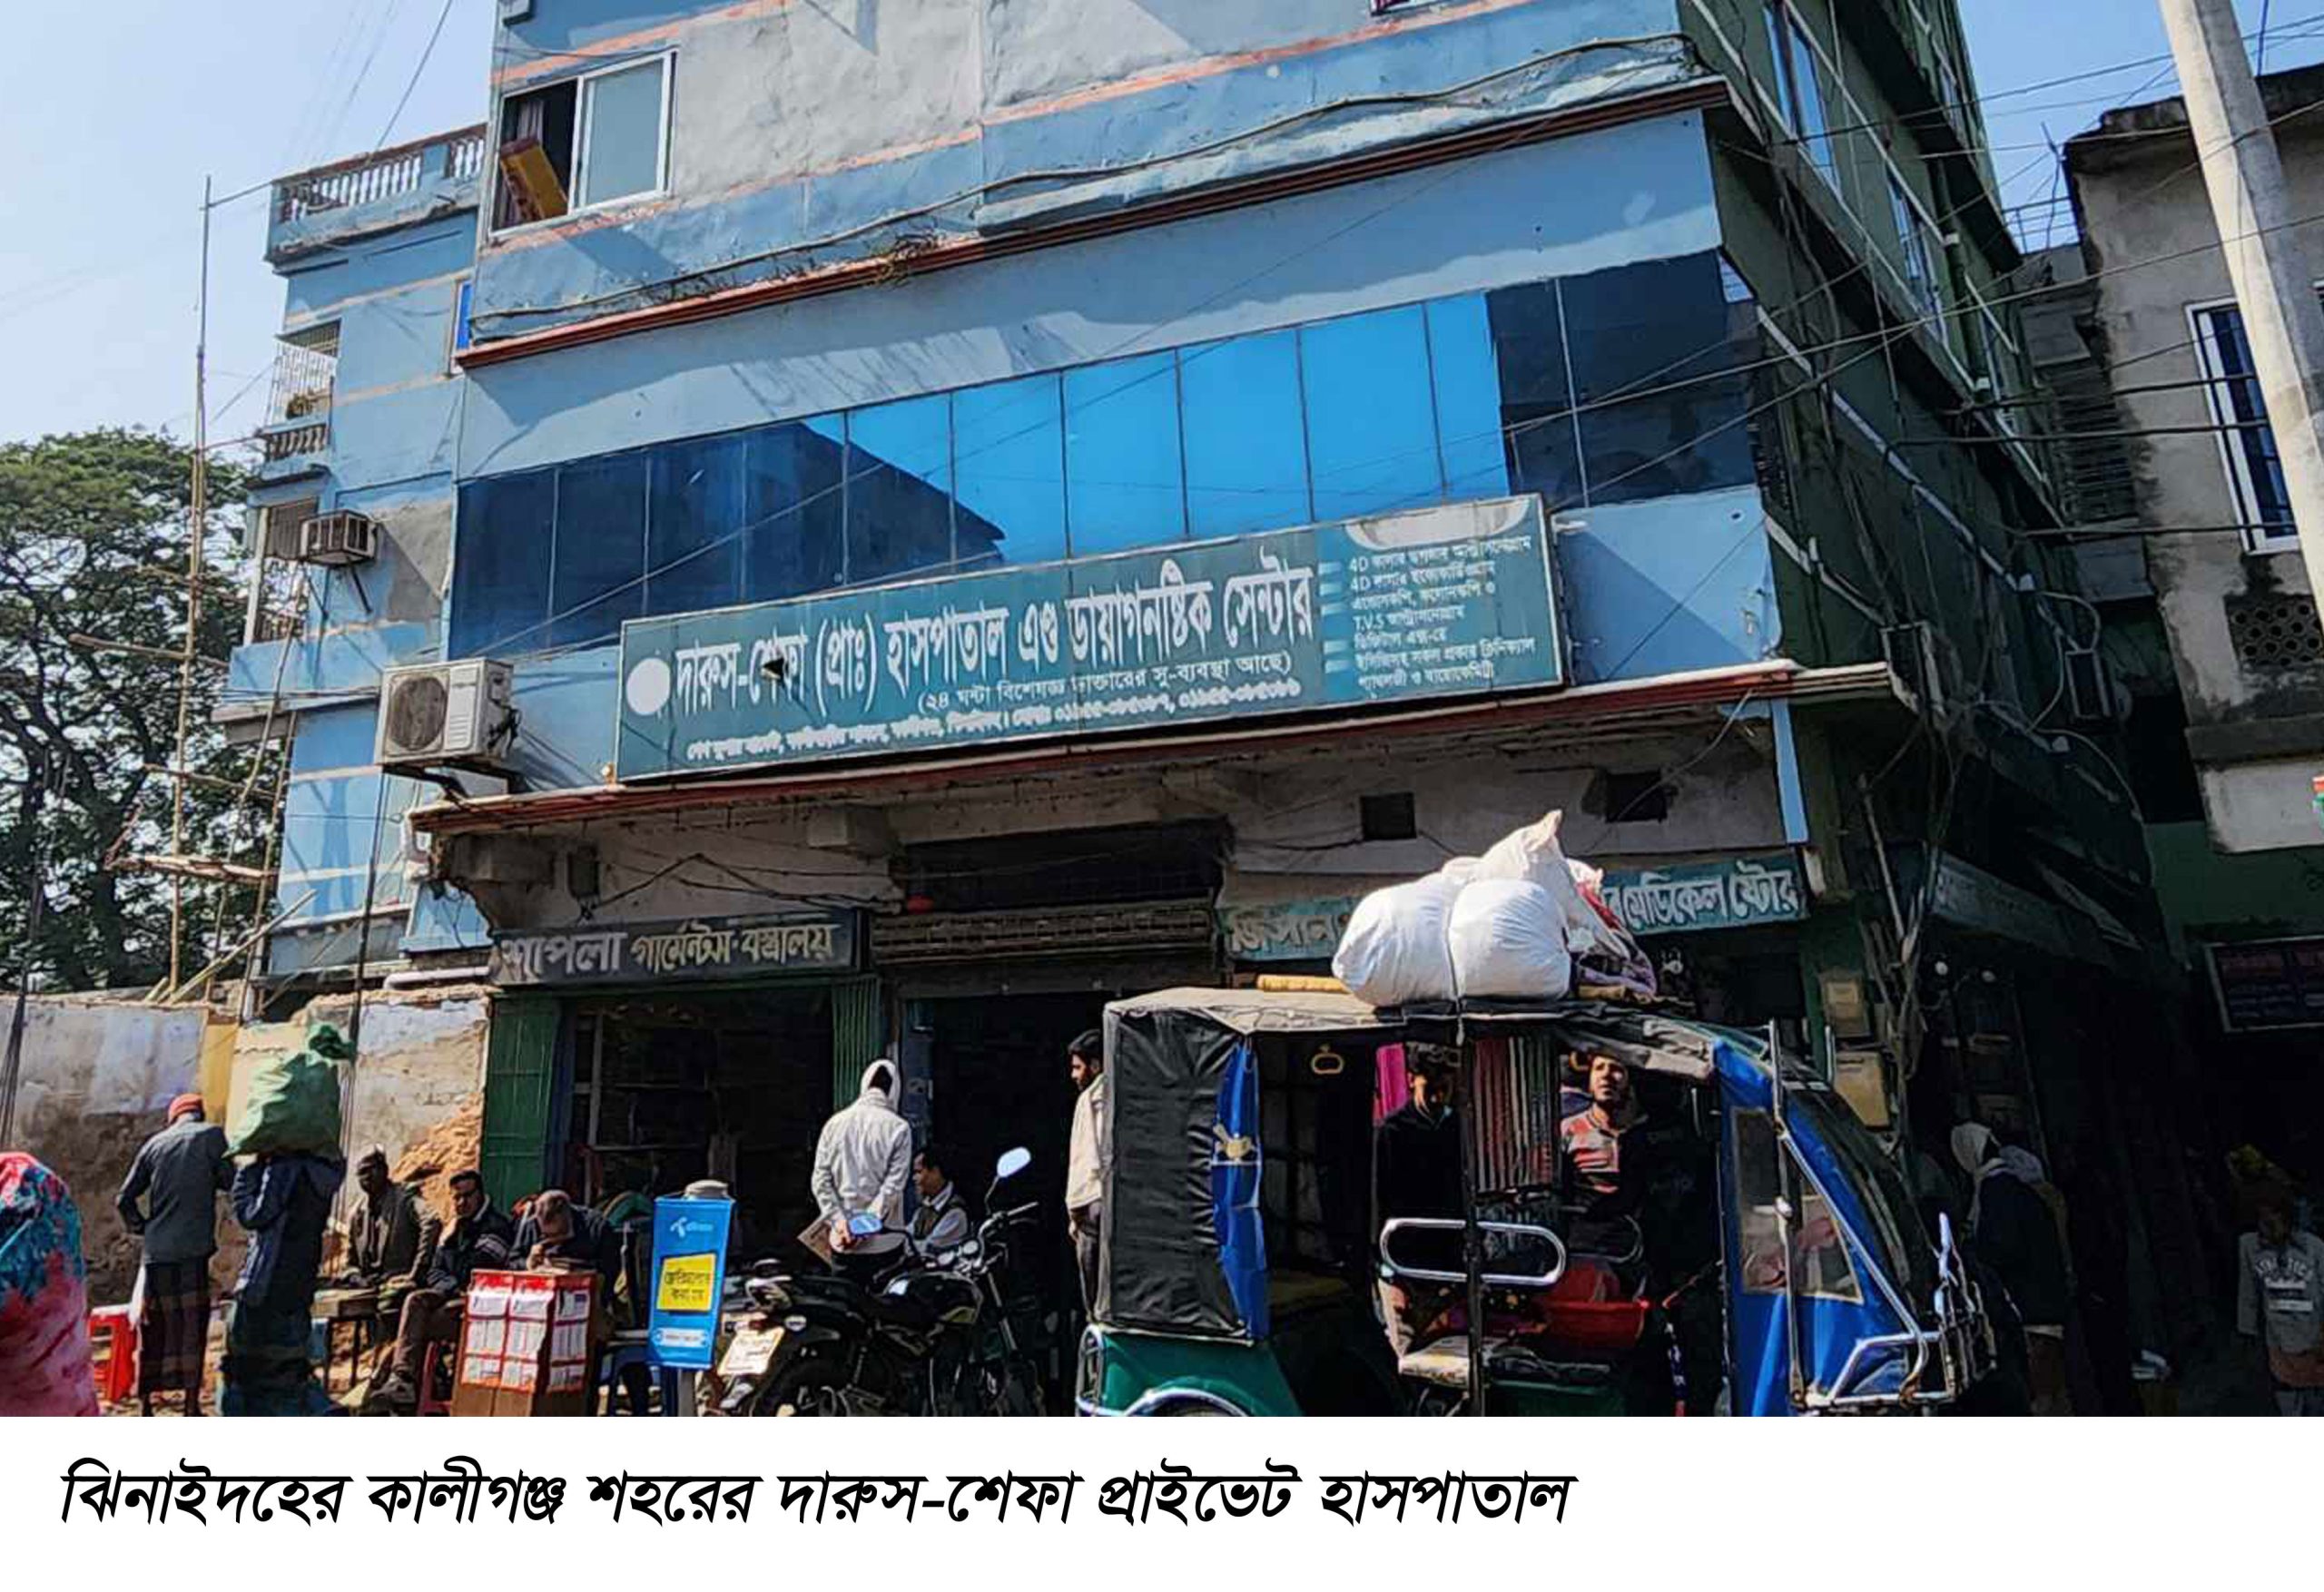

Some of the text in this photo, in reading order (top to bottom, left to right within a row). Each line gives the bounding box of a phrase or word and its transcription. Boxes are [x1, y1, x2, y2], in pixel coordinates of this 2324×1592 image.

[1349, 555, 1369, 573] 4D
[1351, 575, 1372, 591] 4D
[883, 600, 1009, 699] হাসপাতাল
[1064, 558, 1214, 669] ডায়াগনষ্টিক
[1223, 545, 1315, 650] সেন্টার
[1235, 649, 1292, 675] আছে)
[1623, 871, 1728, 930] মেডিকেল
